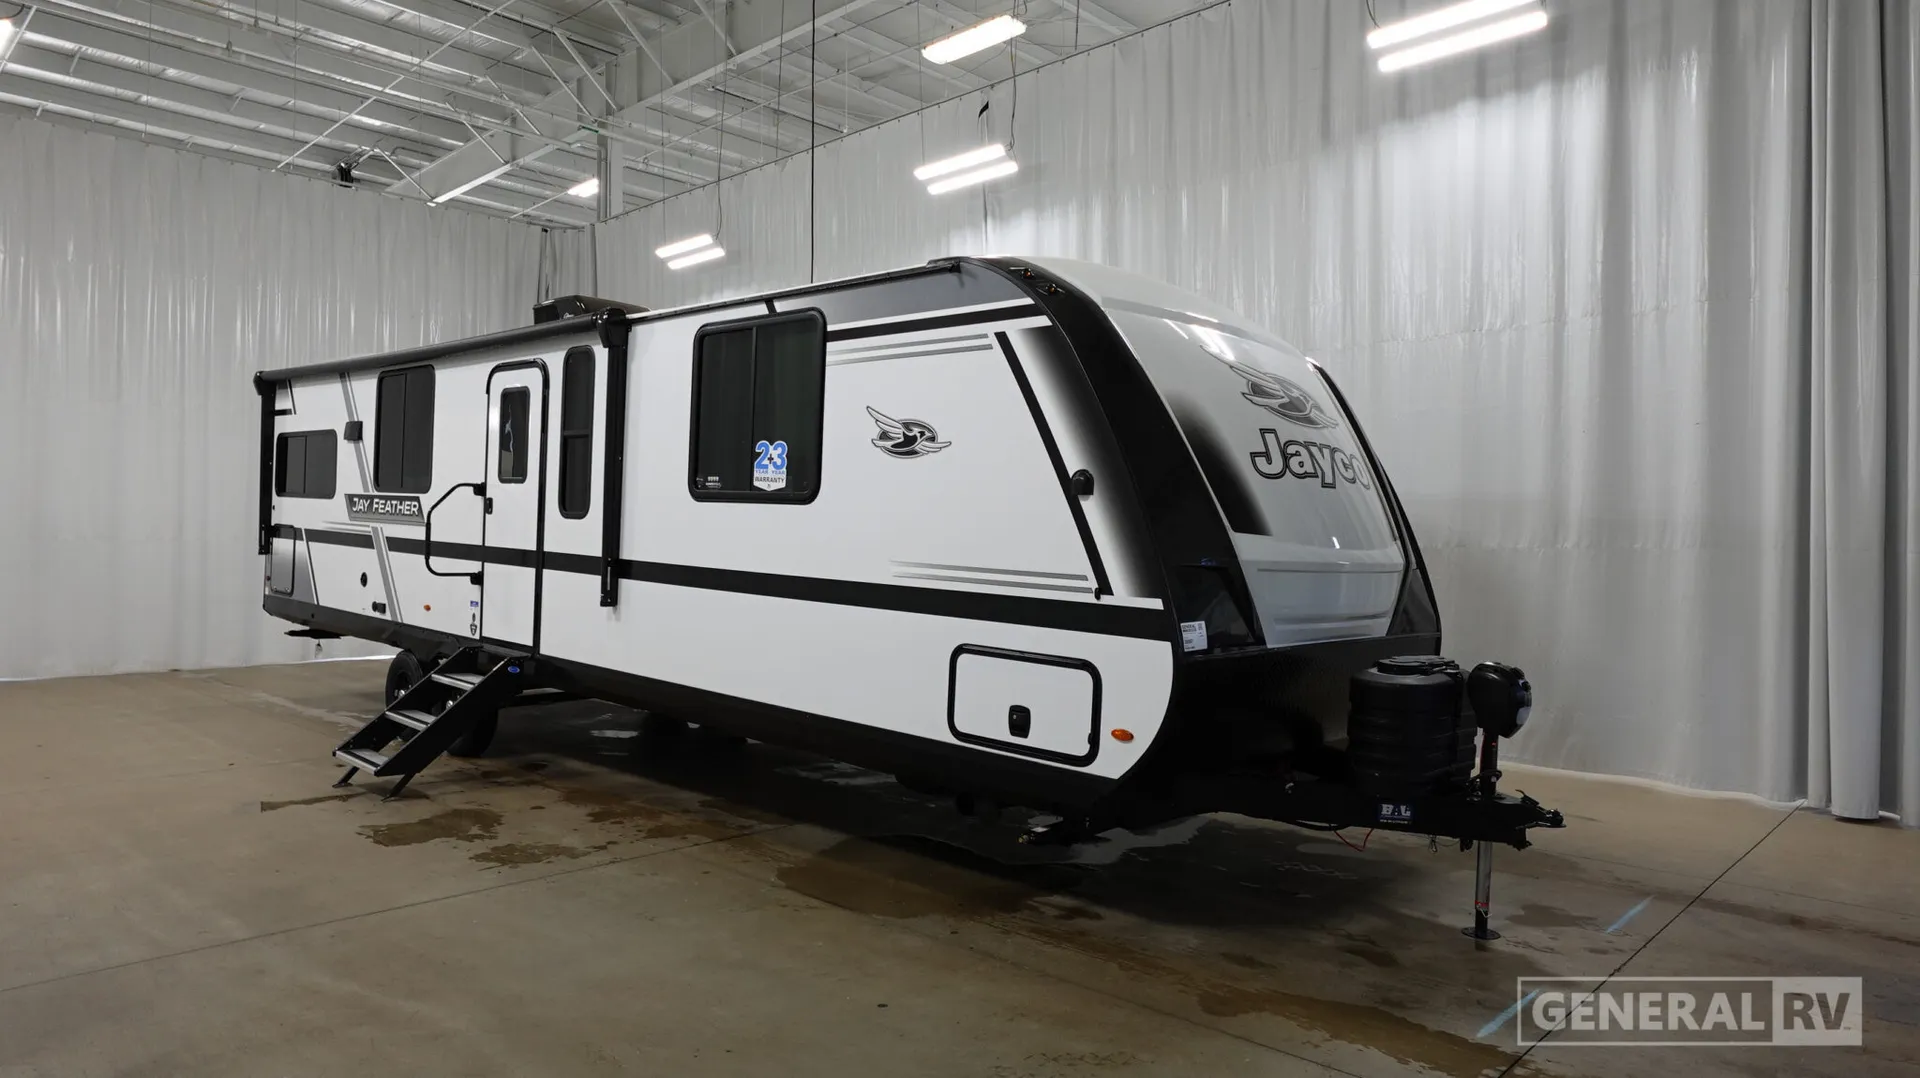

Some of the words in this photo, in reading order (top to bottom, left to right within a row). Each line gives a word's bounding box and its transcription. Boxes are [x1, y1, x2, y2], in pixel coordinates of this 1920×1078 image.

[1250, 428, 1371, 490] Jayco
[352, 497, 370, 512] JAY
[372, 498, 419, 515] FEATHER
